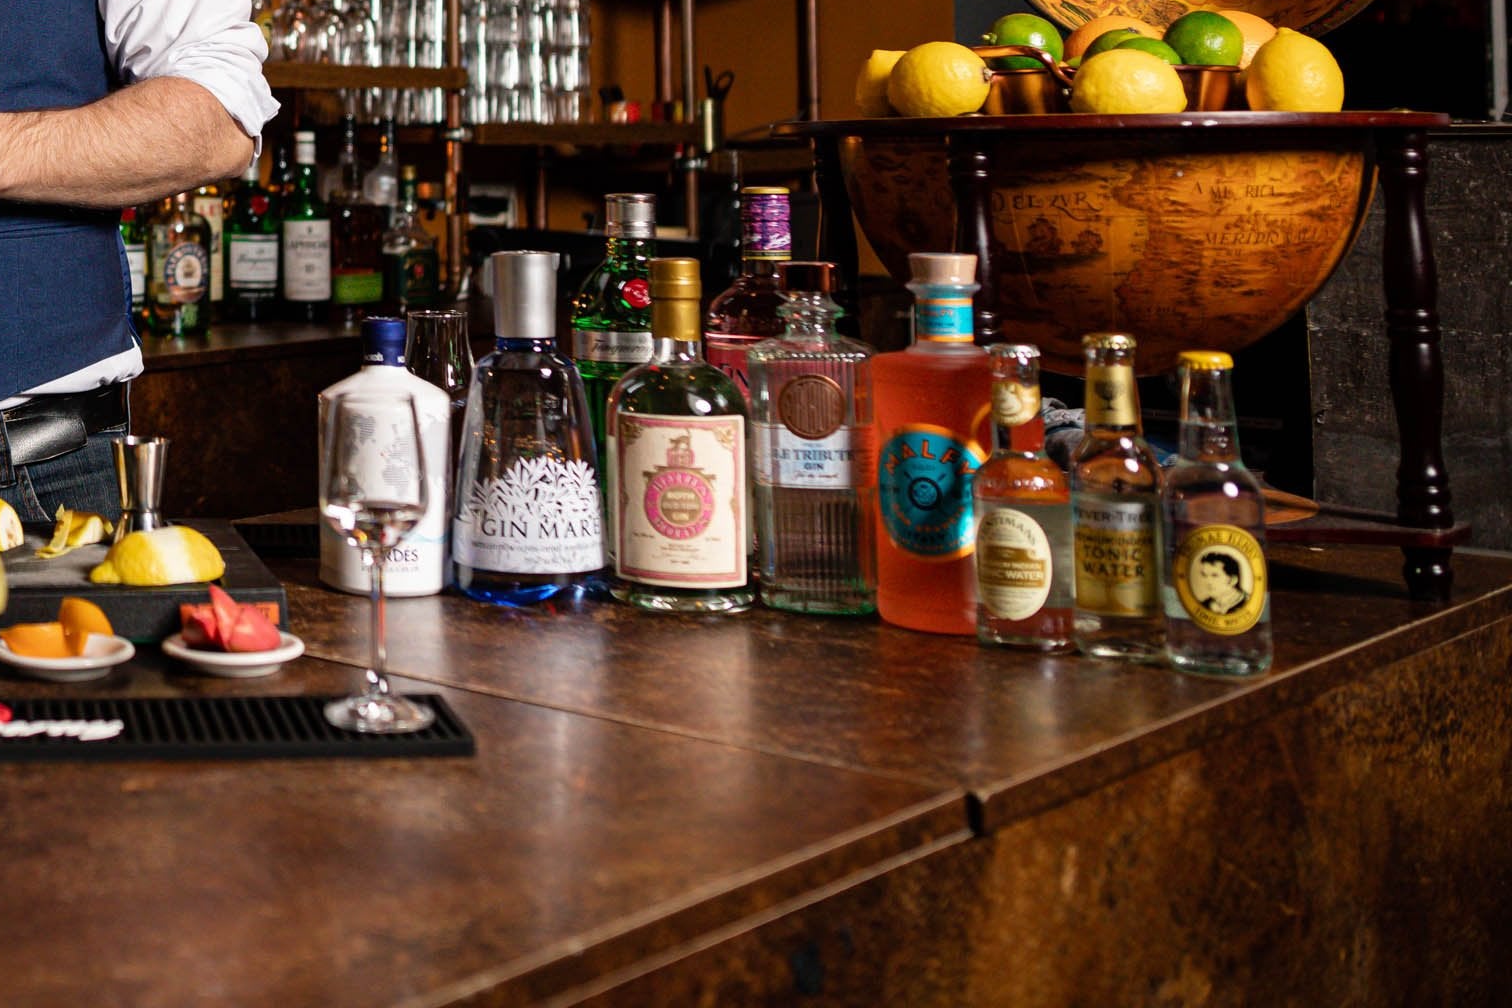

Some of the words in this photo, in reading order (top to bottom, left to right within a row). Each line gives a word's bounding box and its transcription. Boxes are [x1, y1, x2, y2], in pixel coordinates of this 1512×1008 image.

[885, 438, 978, 475] MALFY
[803, 462, 824, 471] GIN
[481, 518, 528, 539] GIN
[538, 517, 600, 539] MARE
[1083, 544, 1144, 561] TONIC
[1083, 561, 1145, 577] WATER
